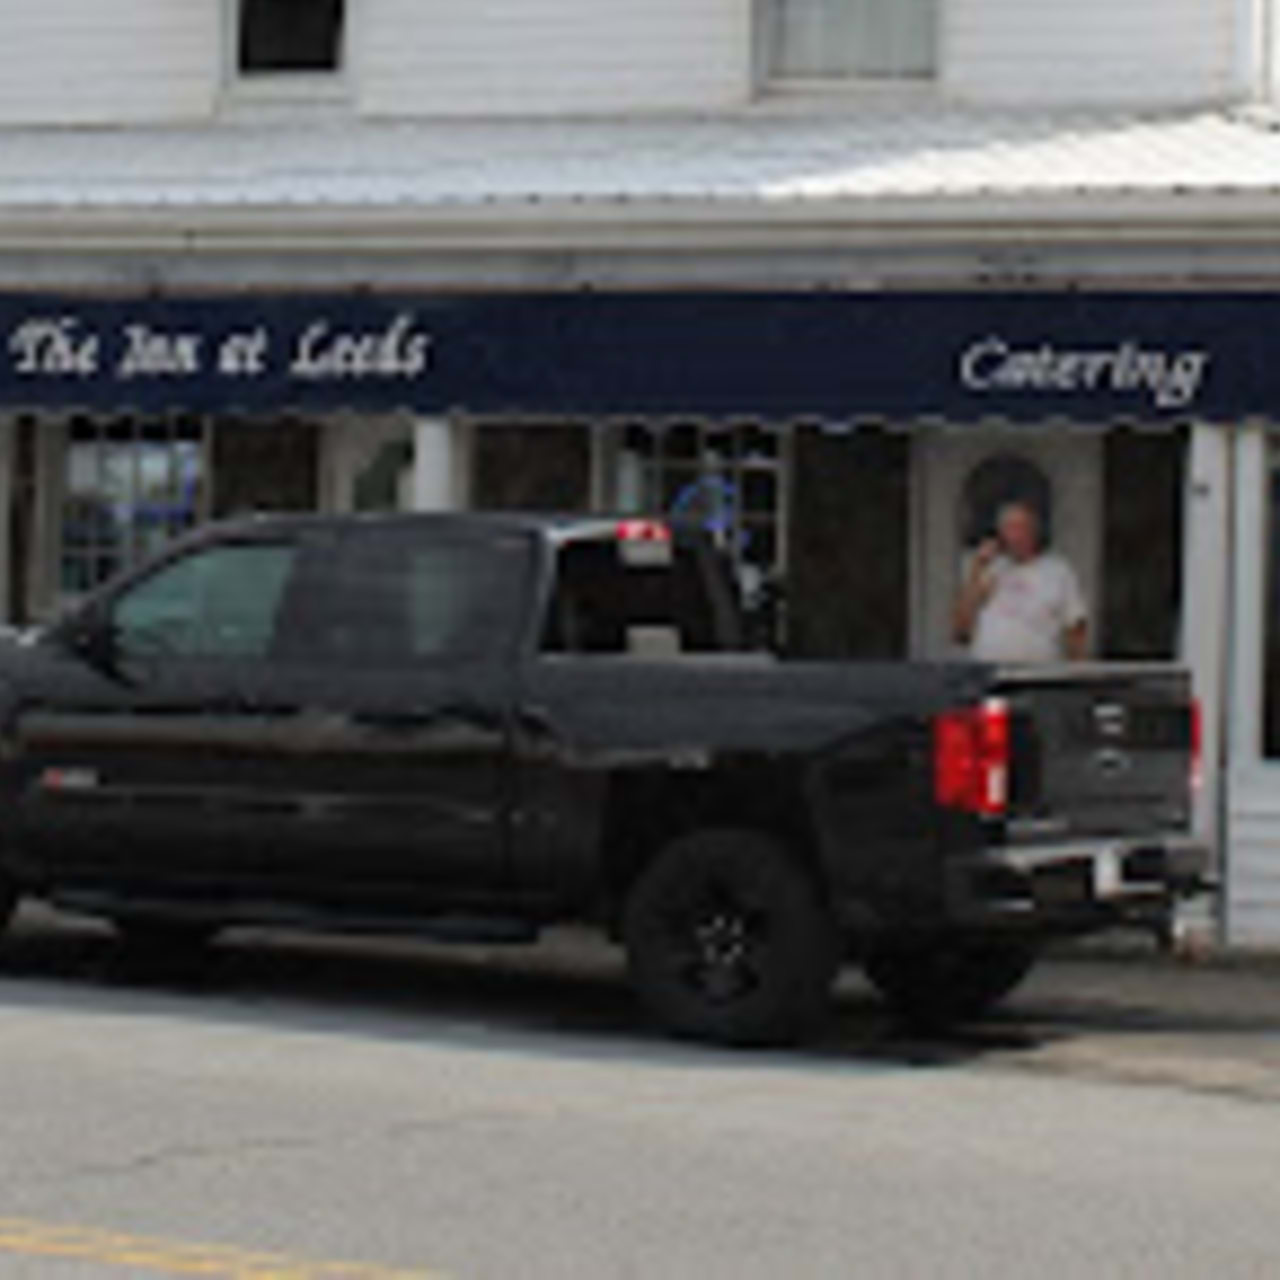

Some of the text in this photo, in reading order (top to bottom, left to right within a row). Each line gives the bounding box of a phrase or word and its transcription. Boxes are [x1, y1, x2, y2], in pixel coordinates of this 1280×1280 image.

[9, 318, 99, 373] The
[219, 326, 267, 374] at
[291, 314, 432, 377] Leeds
[959, 336, 1209, 407] Catering
